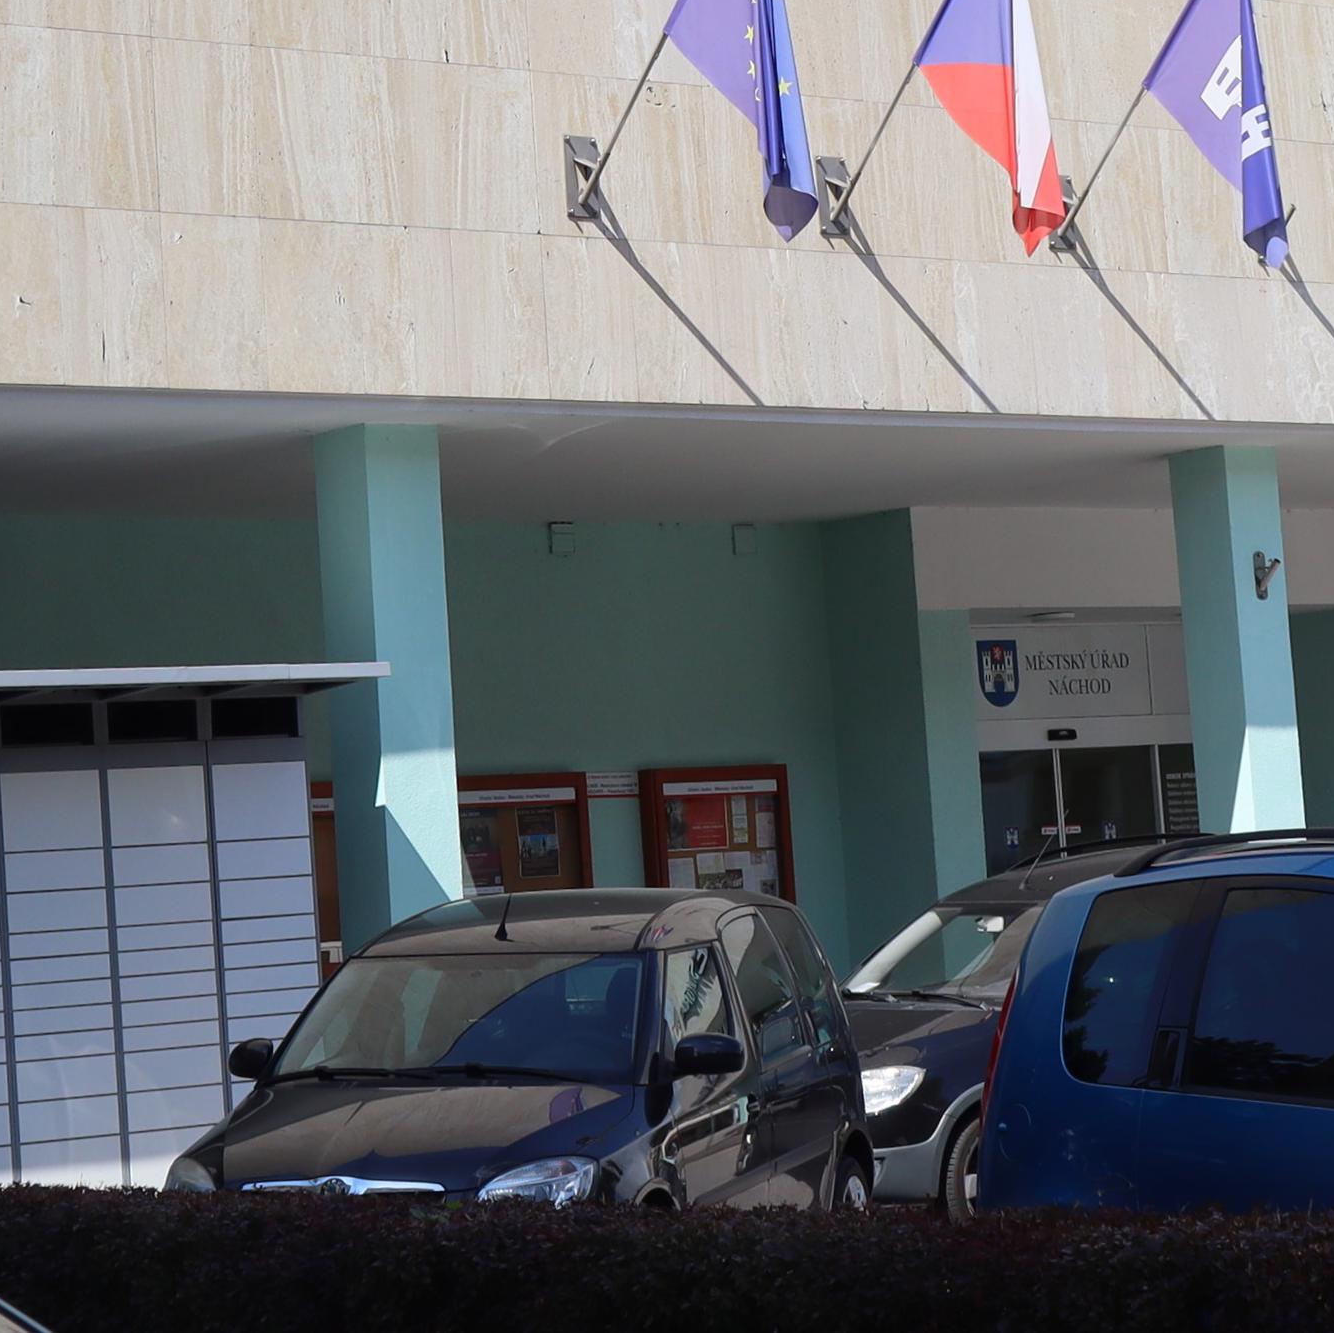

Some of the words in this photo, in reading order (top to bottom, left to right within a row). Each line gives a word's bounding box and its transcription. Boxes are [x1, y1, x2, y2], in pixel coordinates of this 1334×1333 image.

[1025, 650, 1087, 671] MĚSTSKÝ
[1090, 649, 1129, 668] ÚŘAD
[1048, 675, 1111, 696] NÁCHOD
